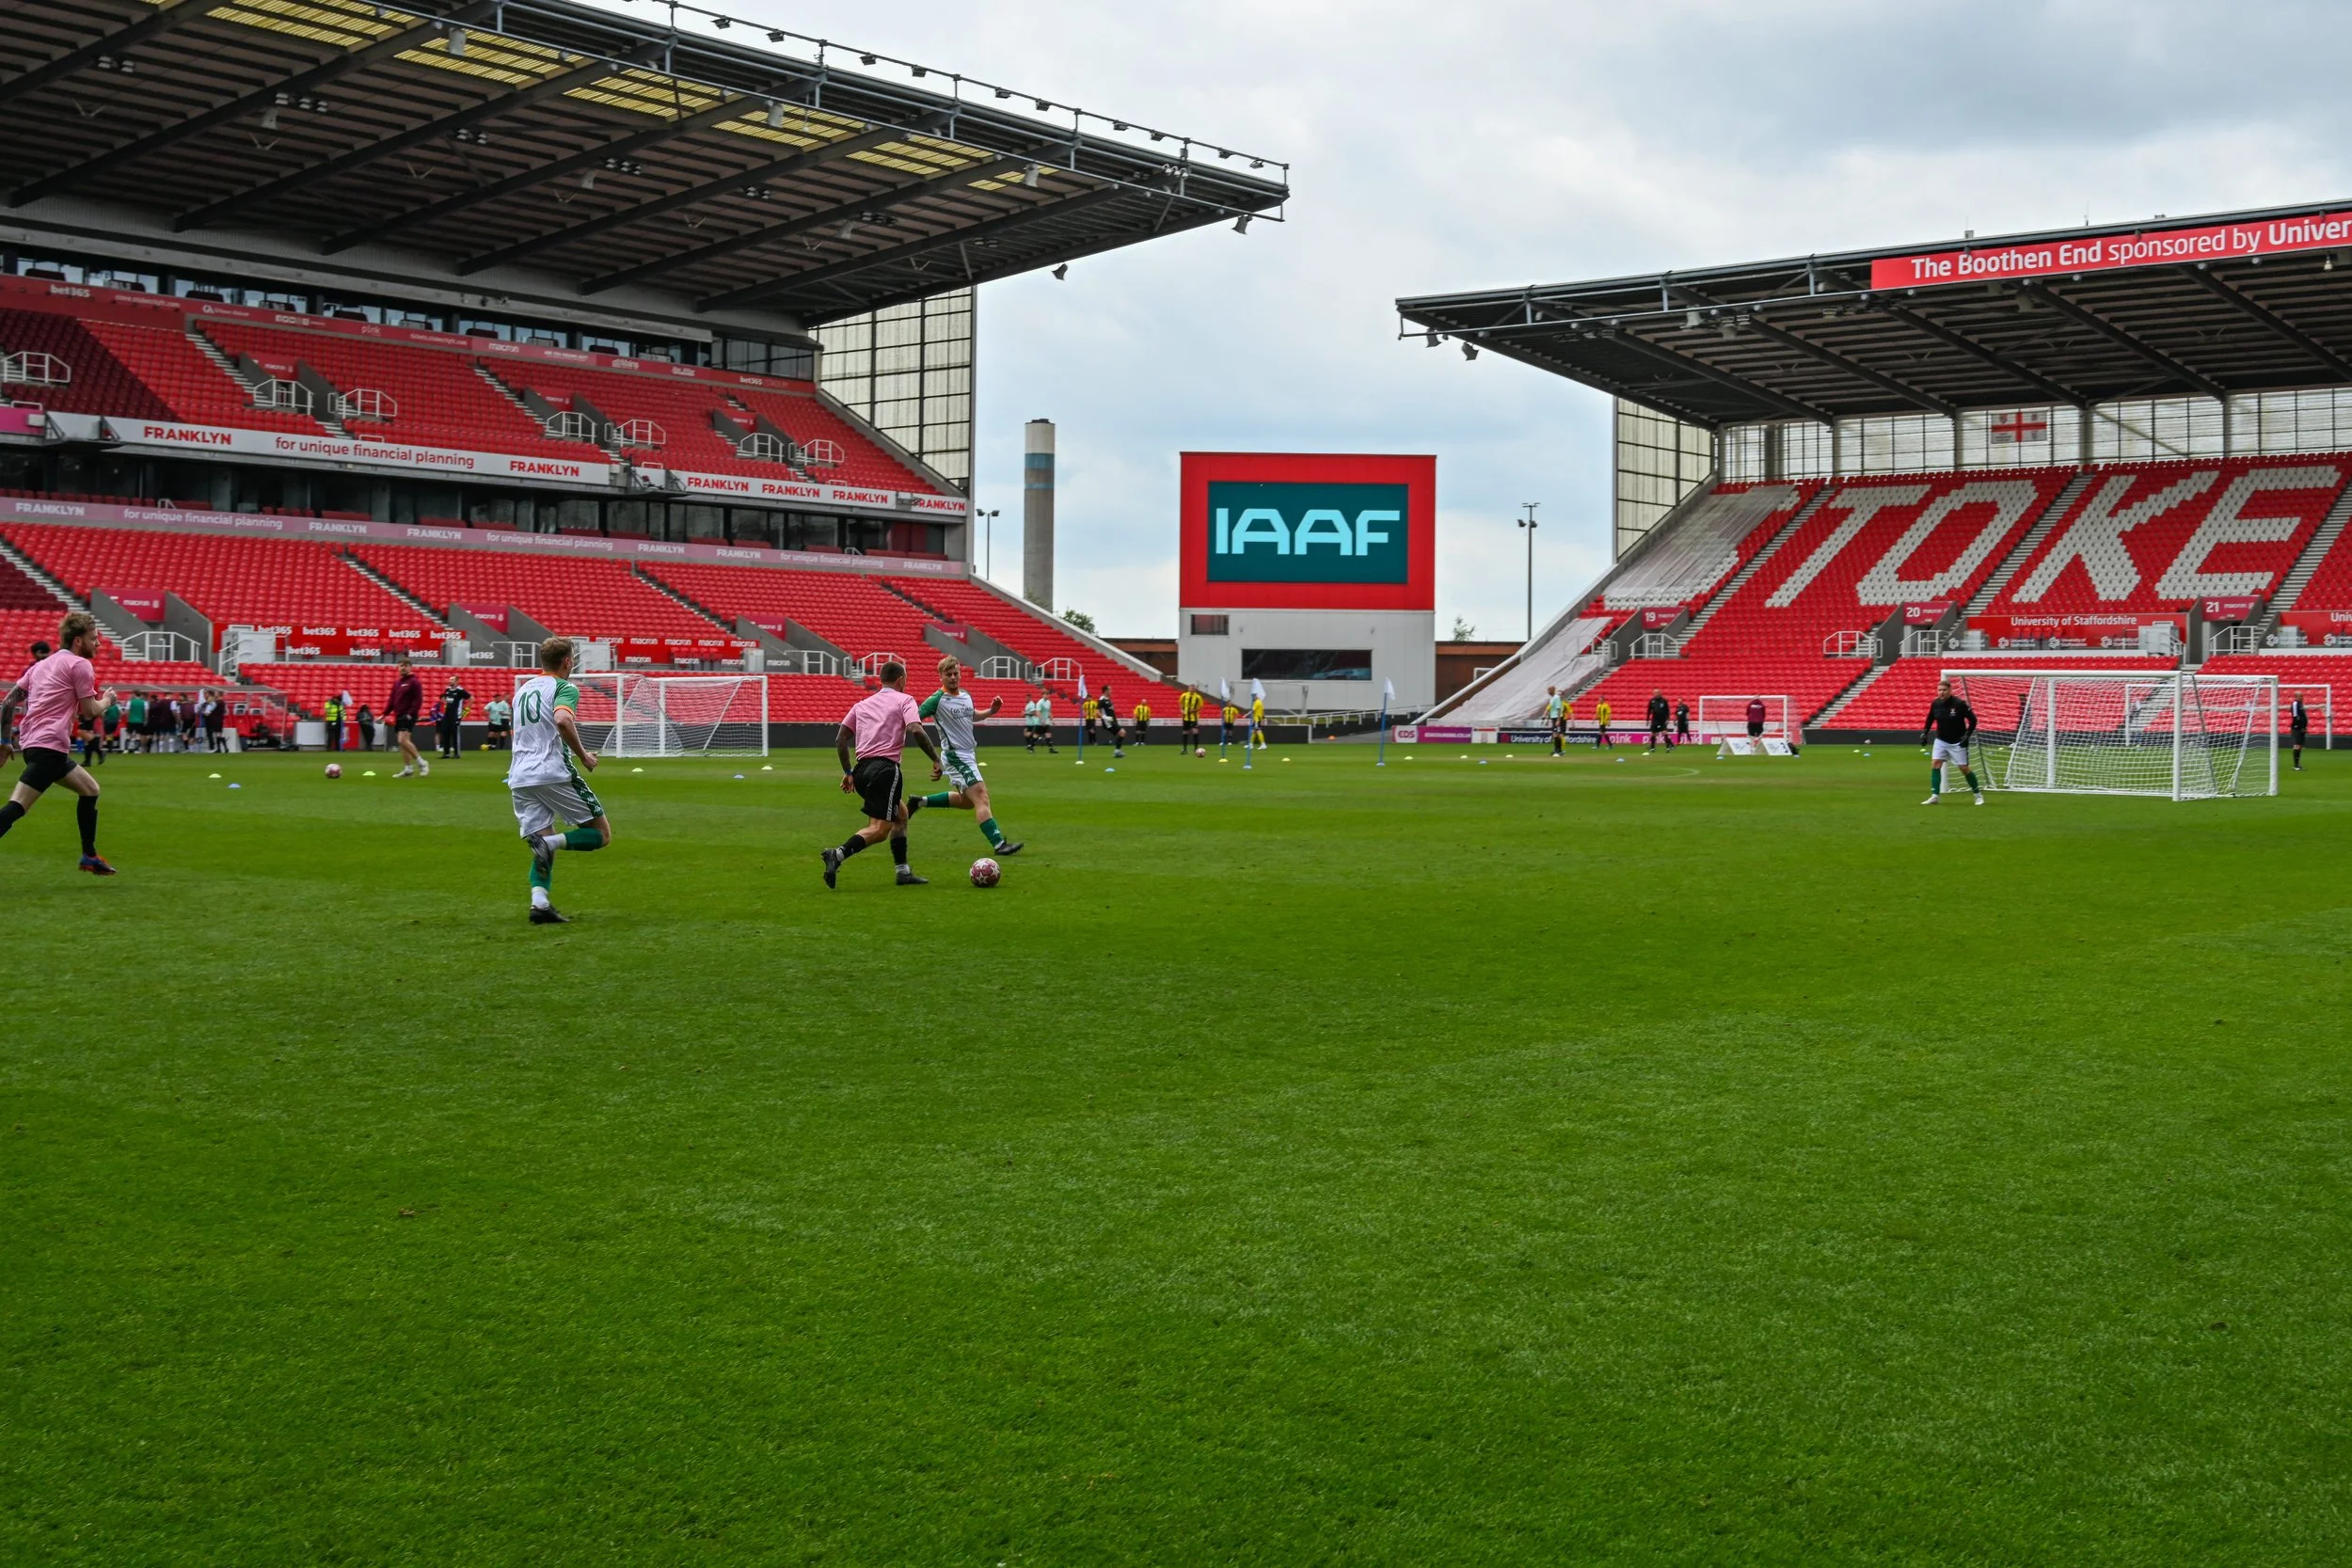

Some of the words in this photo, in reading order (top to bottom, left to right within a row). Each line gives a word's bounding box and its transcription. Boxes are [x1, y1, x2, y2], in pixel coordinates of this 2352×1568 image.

[1912, 258, 1951, 279] The
[1958, 250, 2052, 275] Boothen
[2059, 241, 2102, 265] End
[2108, 229, 2226, 264] sponsored
[2233, 228, 2261, 253] by
[2268, 219, 2352, 245] Univer
[50, 284, 90, 298] bet365
[488, 343, 519, 353] macron
[144, 425, 232, 445] FRANKLYN
[276, 436, 294, 451] for
[299, 439, 349, 456] unique
[354, 442, 412, 461] financial
[416, 451, 474, 469] planning
[510, 460, 580, 477] FRANKLYN
[688, 477, 749, 492] FRANKLYN
[762, 483, 820, 499] FRANKLYN
[833, 490, 888, 504] FRANKLYN
[15, 501, 85, 516] FRANKLYN
[123, 508, 139, 519] for
[142, 510, 183, 523] unique
[185, 512, 232, 526] financial
[235, 515, 283, 531] planning
[309, 521, 367, 534] FRANKLYN
[406, 528, 462, 541] FRANKLYN
[486, 532, 499, 542] for
[501, 534, 533, 545] unique
[534, 535, 573, 547] financial
[574, 538, 613, 551] planning
[638, 543, 685, 554] FRANKLYN
[717, 548, 761, 560] FRANKLYN
[780, 551, 790, 561] for
[792, 553, 818, 563] unique
[819, 554, 850, 565] financial
[851, 558, 883, 568] planning
[903, 561, 942, 571] FRANKLYN
[1216, 508, 1400, 556] IAAF
[1906, 607, 1920, 617] 20
[2205, 601, 2219, 612] 21
[1645, 611, 1656, 622] 19
[2010, 616, 2059, 627] University
[2061, 616, 2071, 626] of
[2074, 616, 2137, 626] Staffordshire
[2330, 612, 2352, 622] Univ
[258, 625, 292, 634] bet365
[302, 626, 337, 636] bet365
[346, 628, 379, 637] bet365
[389, 629, 421, 639] bet365
[430, 630, 461, 640] bet365
[289, 646, 321, 655] bet365
[349, 647, 380, 657] bet365
[408, 649, 438, 658] bet365
[466, 650, 495, 659] bet365
[518, 689, 541, 726] 10
[1398, 730, 1415, 738] EDS
[1511, 736, 1544, 744] University
